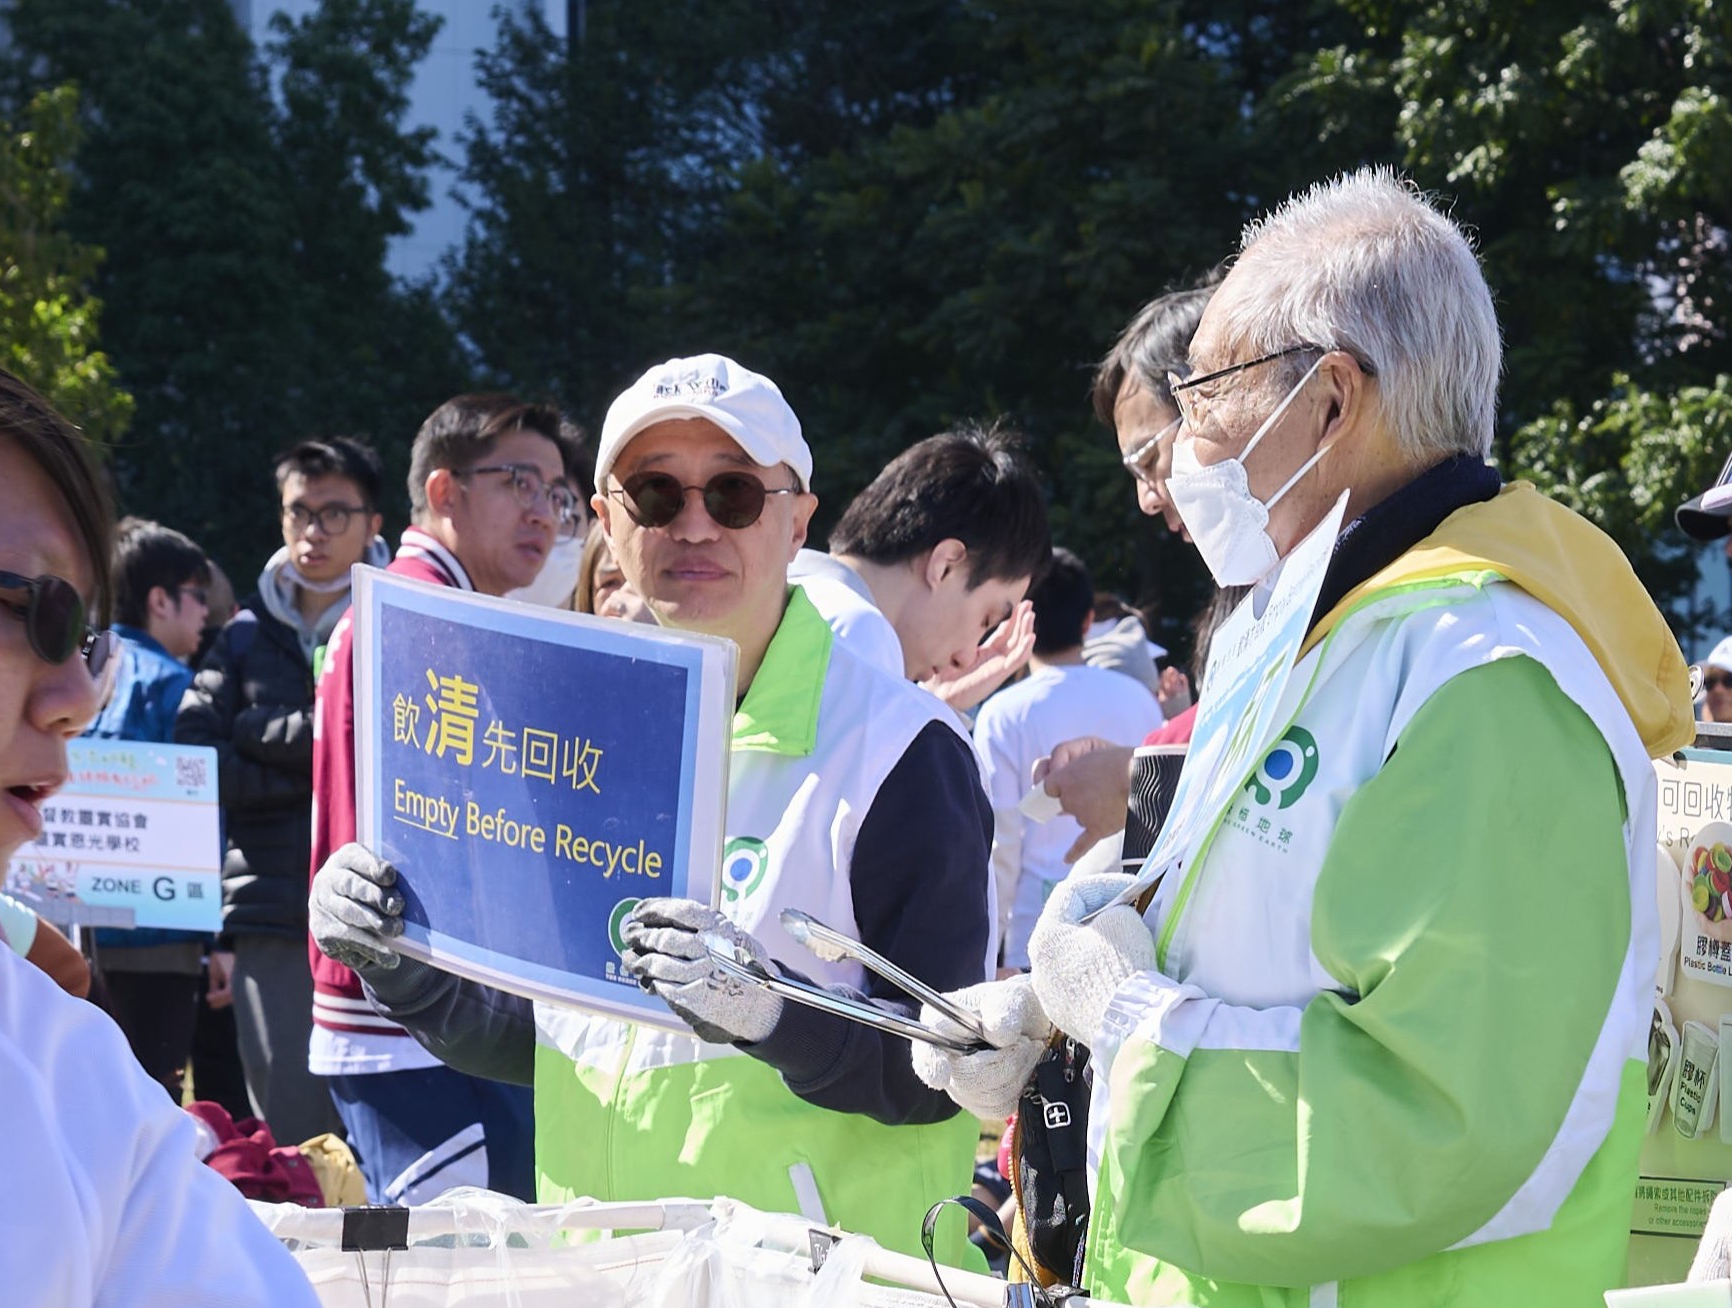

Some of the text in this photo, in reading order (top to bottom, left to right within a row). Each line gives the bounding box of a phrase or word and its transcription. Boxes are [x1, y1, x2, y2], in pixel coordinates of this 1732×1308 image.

[392, 668, 603, 794] 飲清先回收
[394, 778, 663, 879] Empty Before Recycle
[91, 876, 142, 894] ZONE
[153, 876, 176, 901] G
[1684, 956, 1706, 970] Plastic
